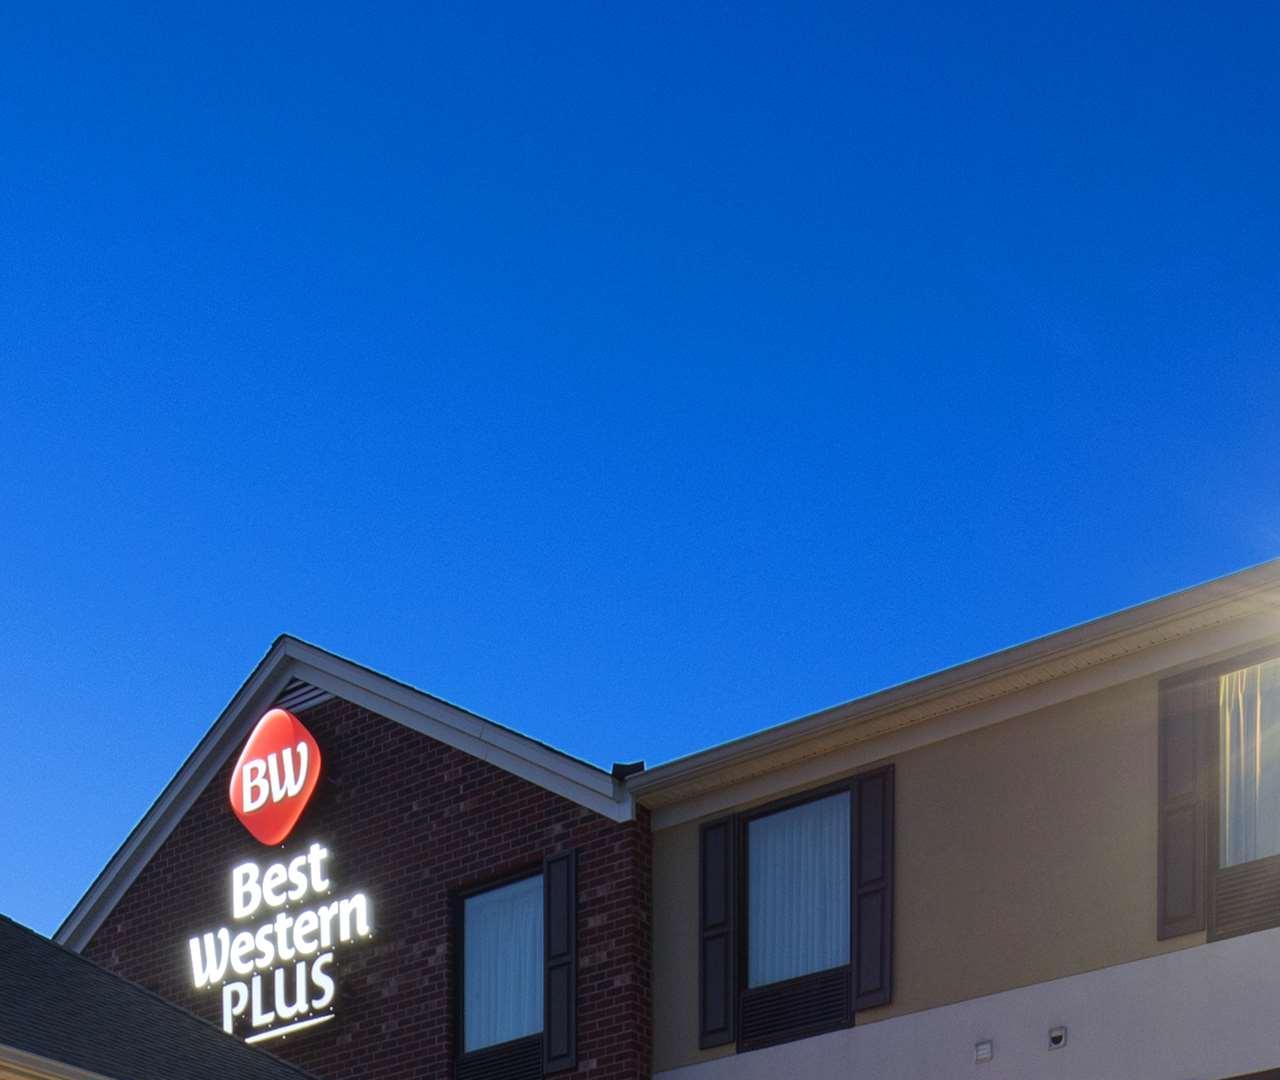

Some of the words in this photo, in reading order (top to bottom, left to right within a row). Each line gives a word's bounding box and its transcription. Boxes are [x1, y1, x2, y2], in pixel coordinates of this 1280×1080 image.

[241, 741, 308, 813] BW
[232, 842, 330, 919] Best
[189, 892, 371, 989] Western
[222, 952, 335, 1034] PLUS
